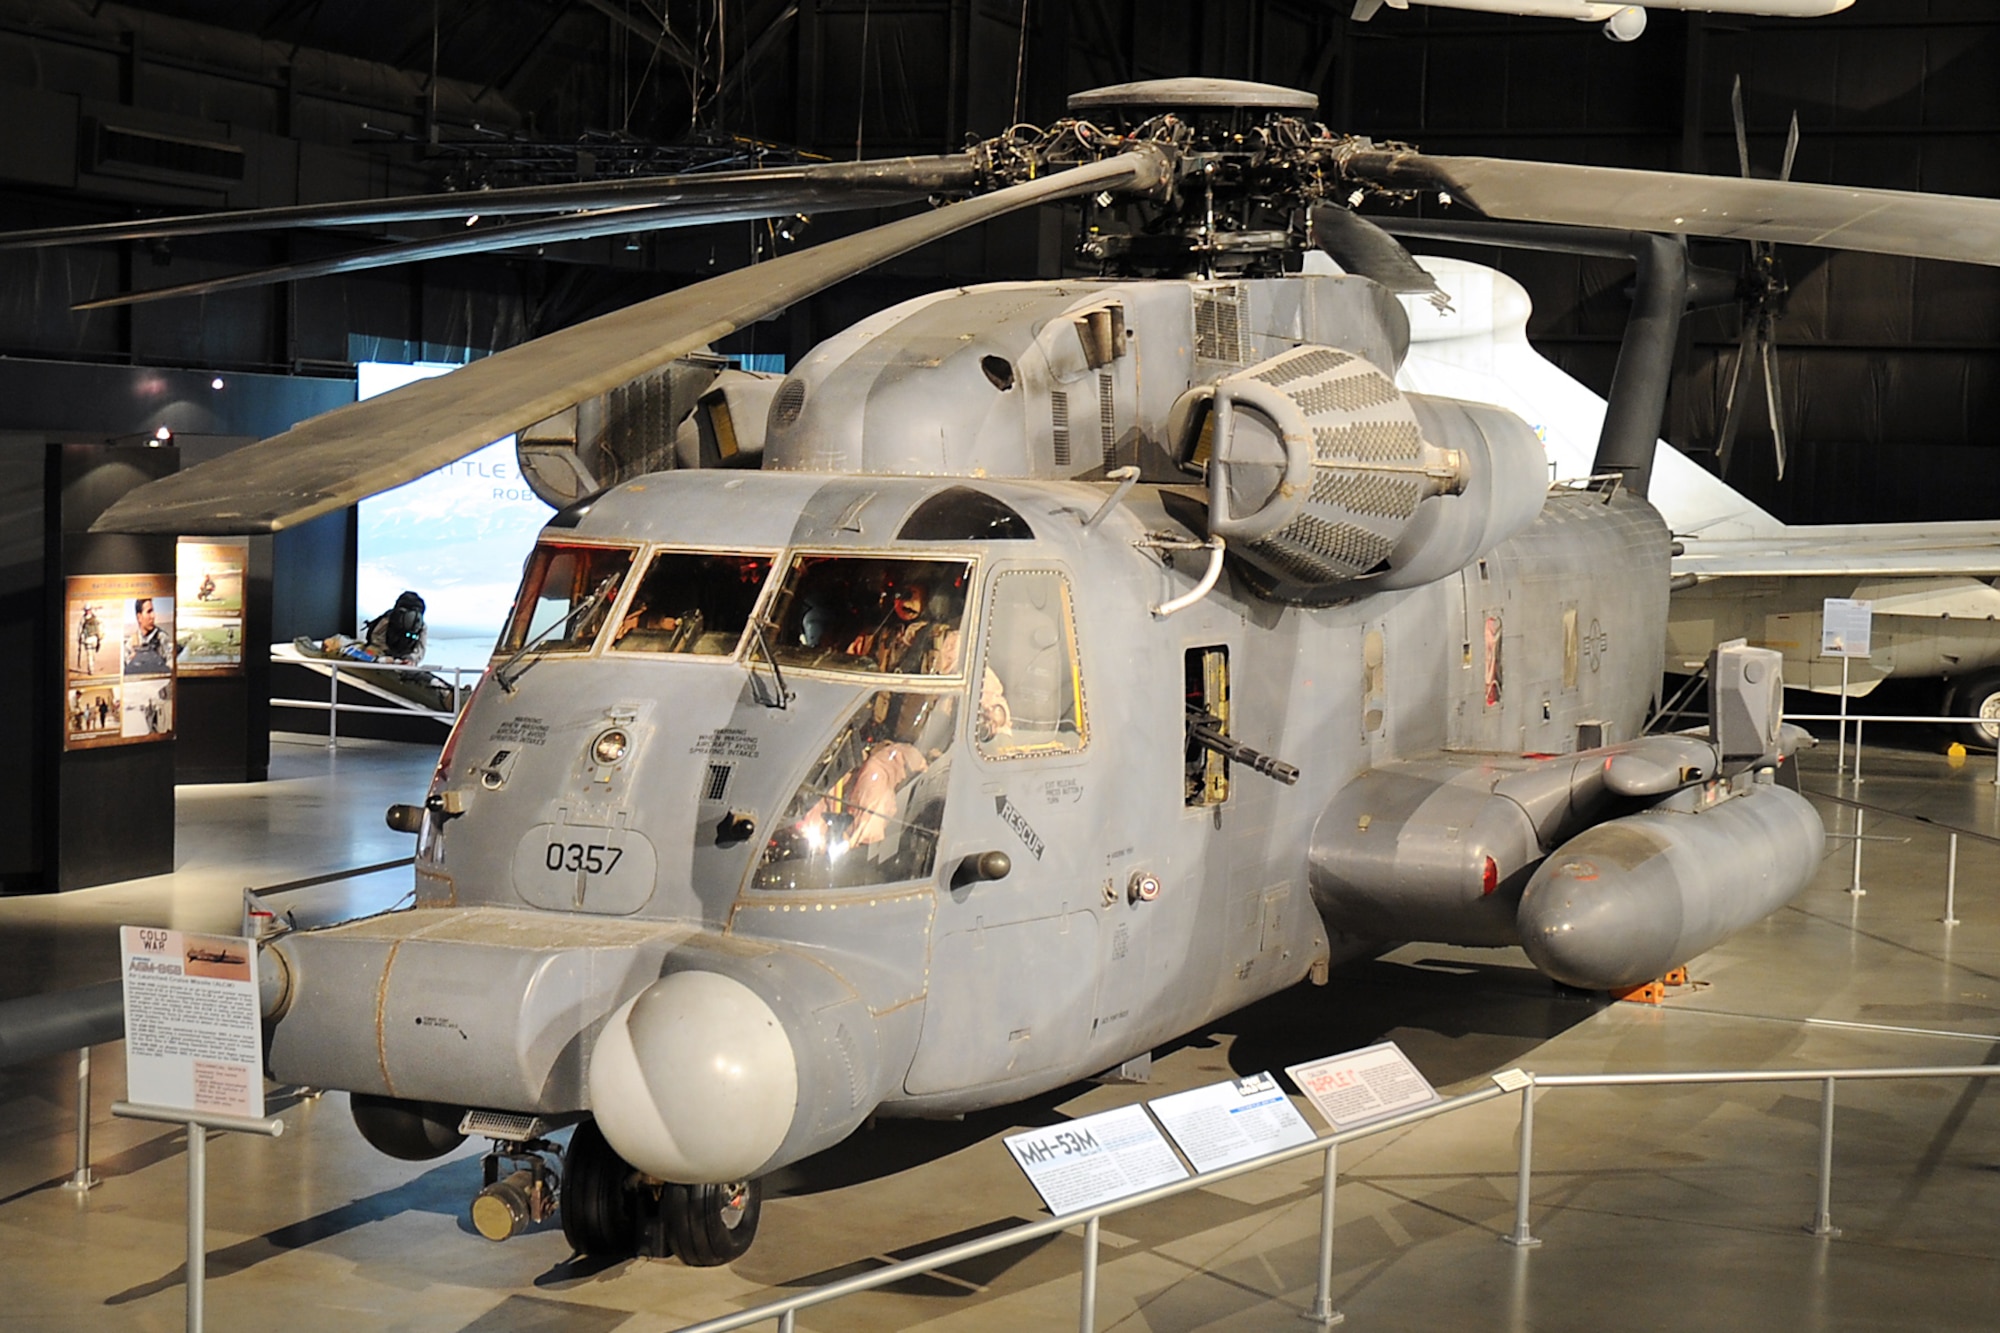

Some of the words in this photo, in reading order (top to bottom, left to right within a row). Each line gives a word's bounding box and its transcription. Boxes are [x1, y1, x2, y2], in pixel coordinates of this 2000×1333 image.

[1001, 802, 1042, 859] RESCUE
[546, 843, 623, 875] 0357
[140, 930, 168, 941] COLD
[143, 940, 165, 952] WAR
[1016, 1128, 1100, 1166] MH-53M
